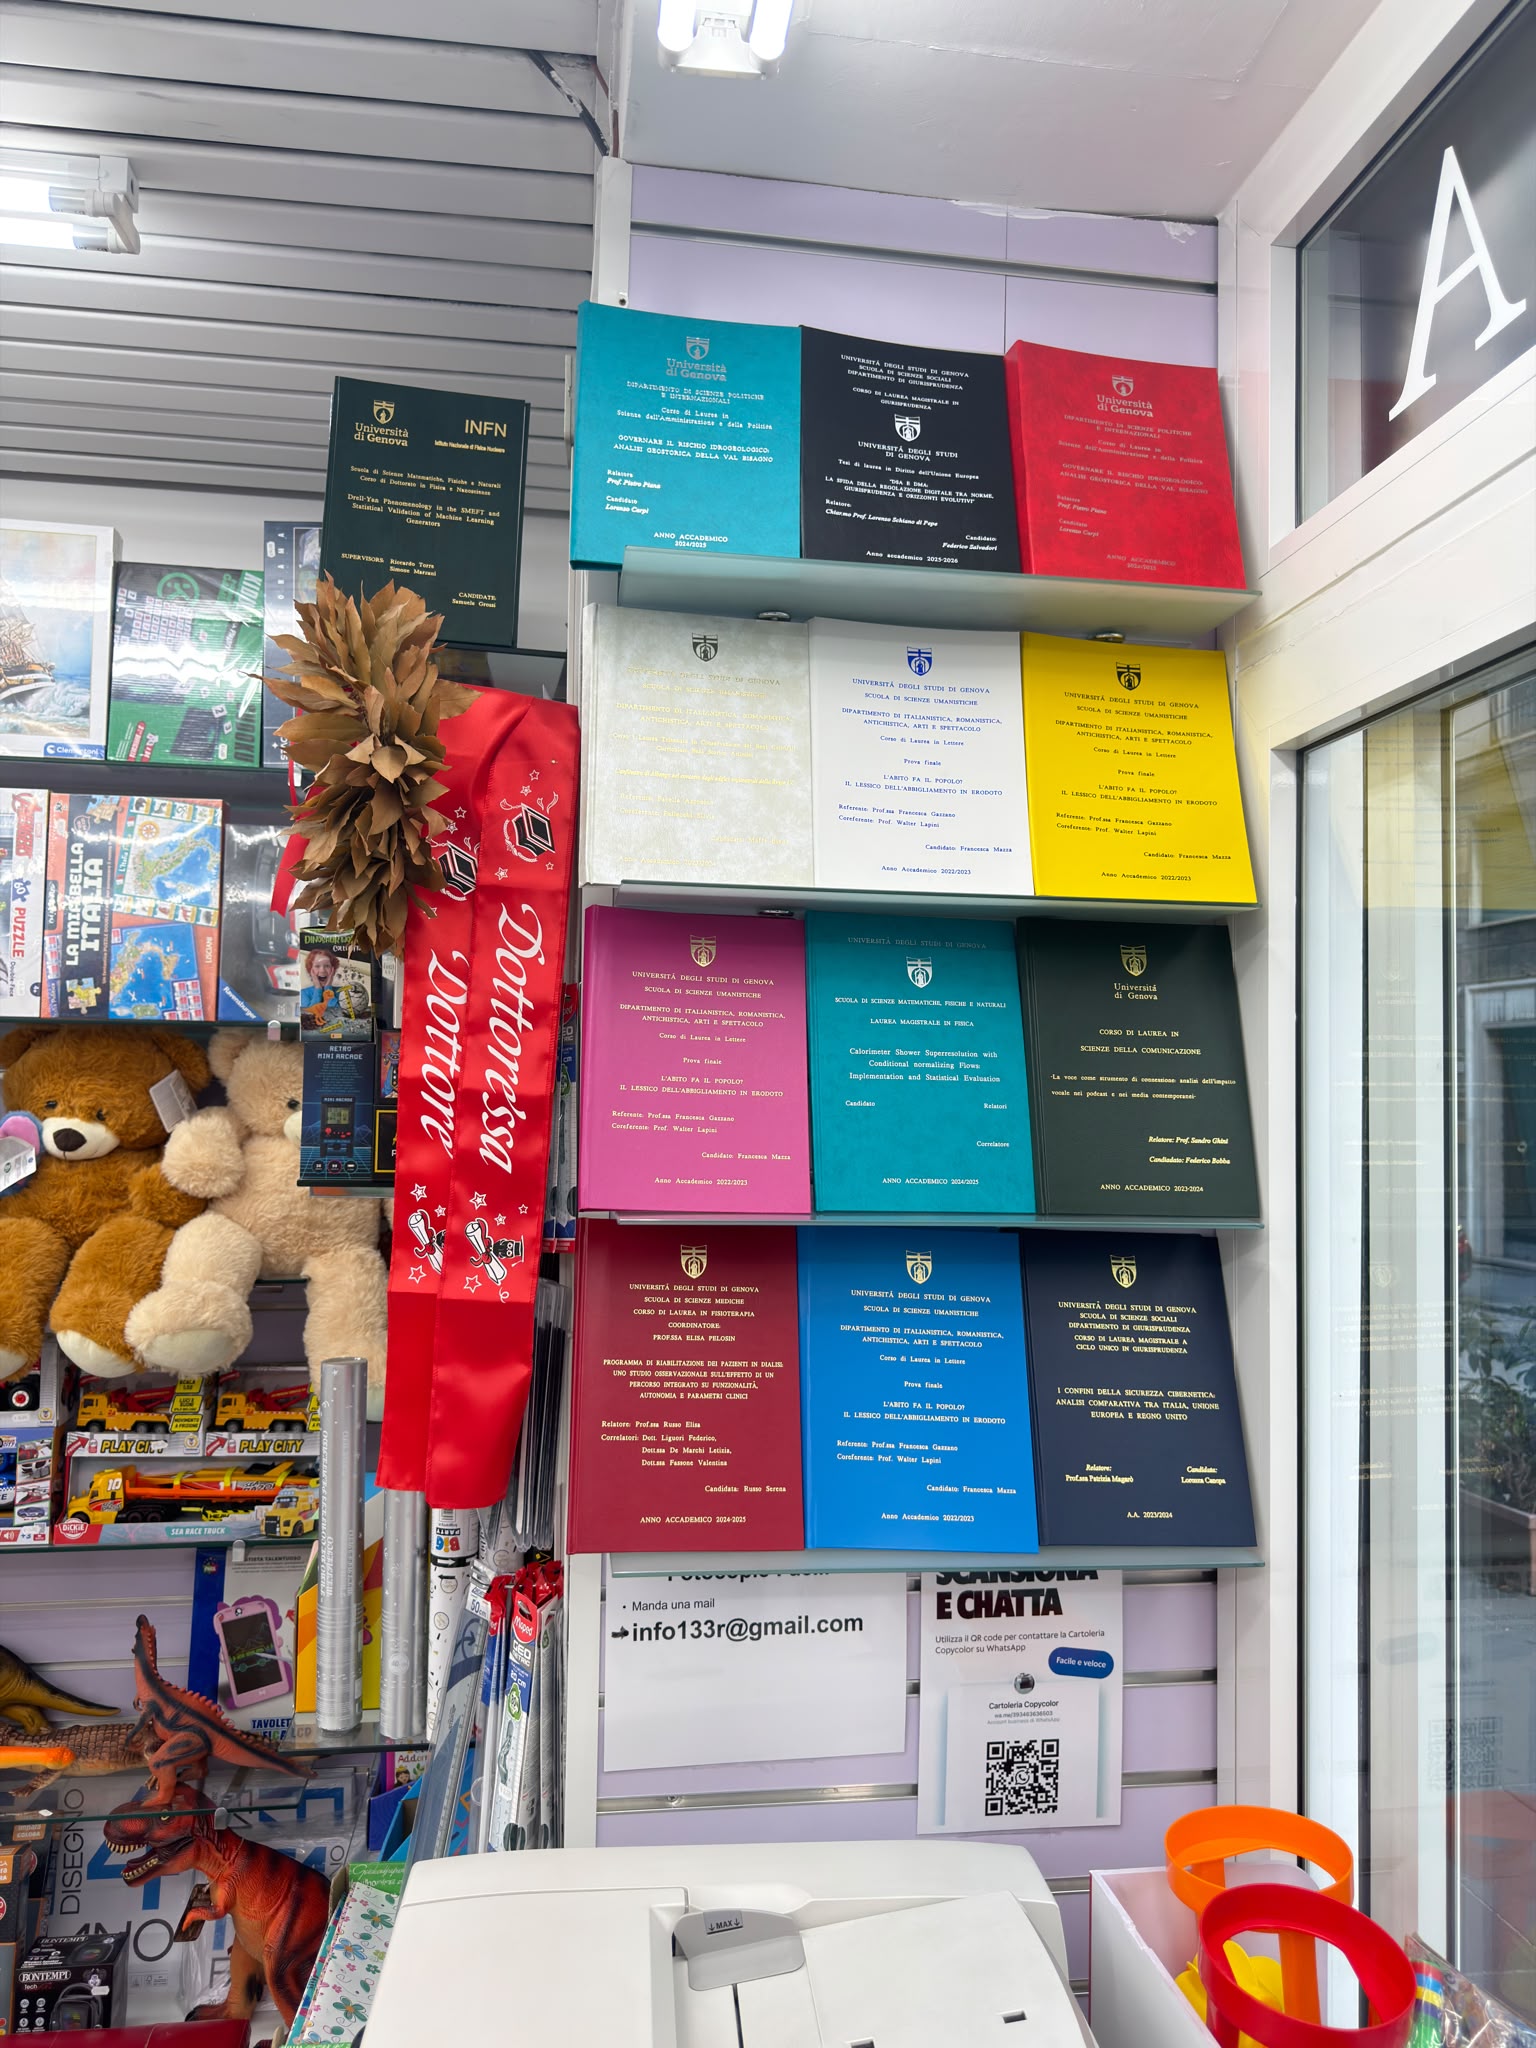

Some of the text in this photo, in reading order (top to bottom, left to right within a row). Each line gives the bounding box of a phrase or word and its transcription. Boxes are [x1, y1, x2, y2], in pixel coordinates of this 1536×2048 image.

[1388, 145, 1526, 421] A
[1097, 394, 1153, 411] Università
[1097, 403, 1154, 418] di Genova
[355, 422, 409, 438] Università
[465, 419, 507, 438] INFN
[354, 432, 408, 447] di Genova
[618, 435, 663, 446] GOVERNARE
[677, 441, 707, 449] RISCHIO
[347, 493, 379, 504] Drell-Yan
[383, 498, 433, 511] Phenomenology
[352, 502, 384, 512] Statistical
[387, 506, 421, 517] Validation
[435, 512, 463, 522] Machine
[466, 515, 495, 526] Learning
[406, 517, 441, 527] Generators
[866, 550, 884, 558] Anno
[390, 558, 416, 567] Riccardo
[1071, 791, 1097, 799] LESSICO
[69, 842, 84, 896] BELLA
[14, 881, 26, 895] 60
[80, 858, 103, 952] ITALIA
[12, 907, 26, 958] PUZZLE
[66, 944, 80, 966] LA
[644, 986, 671, 994] SCUOLA
[716, 991, 761, 999] UMANISTICHE
[1114, 991, 1158, 1000] di Genova
[223, 986, 257, 1019] Ravensburger
[479, 902, 546, 1175] Dottoressa
[1099, 1028, 1123, 1036] CORSO
[420, 948, 470, 1160] Dottore
[849, 1047, 891, 1056] Calorimeter
[895, 1048, 921, 1057] Shower
[925, 1049, 978, 1058] Superresolution
[1080, 1045, 1111, 1053] SCIENZE
[1141, 1047, 1202, 1055] COMUNICAZIONE
[868, 1059, 909, 1068] Conditional
[913, 1061, 955, 1070] normalizing
[849, 1072, 1001, 1083] Implementation and Statistical Evaluation
[845, 1100, 876, 1108] Candidato
[1064, 1387, 1094, 1395] CONFINI
[1097, 1388, 1122, 1396] DELLA
[1124, 1389, 1164, 1397] SICUREZZA
[661, 1434, 685, 1443] Liguori
[100, 1440, 135, 1453] PLAY
[239, 1440, 304, 1453] PLAY CITY
[896, 1455, 918, 1463] Walter
[107, 1478, 123, 1492] 10
[640, 1516, 662, 1524] ANNO
[171, 1526, 226, 1536] SEA RACE TRUCK
[470, 1599, 480, 1614] 50
[632, 1597, 715, 1611] Manda una mail
[936, 1588, 1063, 1620] E CHATTA
[632, 1615, 864, 1642] info133r@gmail.com
[935, 1635, 963, 1643] Utilizza
[970, 1634, 982, 1642] QR
[983, 1633, 1003, 1642] code
[1003, 1634, 1017, 1642] per
[1018, 1632, 1059, 1640] contattare
[1060, 1631, 1067, 1639] la
[1068, 1629, 1105, 1638] Cartoleria
[513, 1640, 531, 1657] GEO
[935, 1646, 974, 1656] Copycolor
[986, 1644, 1026, 1653] WhatsApp
[1056, 1656, 1076, 1666] Facile
[1083, 1659, 1107, 1669] veloce
[988, 1699, 1059, 1710] Cartoleria Copycolor
[60, 1788, 85, 1915] DISEGNO
[716, 1919, 733, 1930] MAX
[22, 1971, 69, 1981] BONTEMPI
